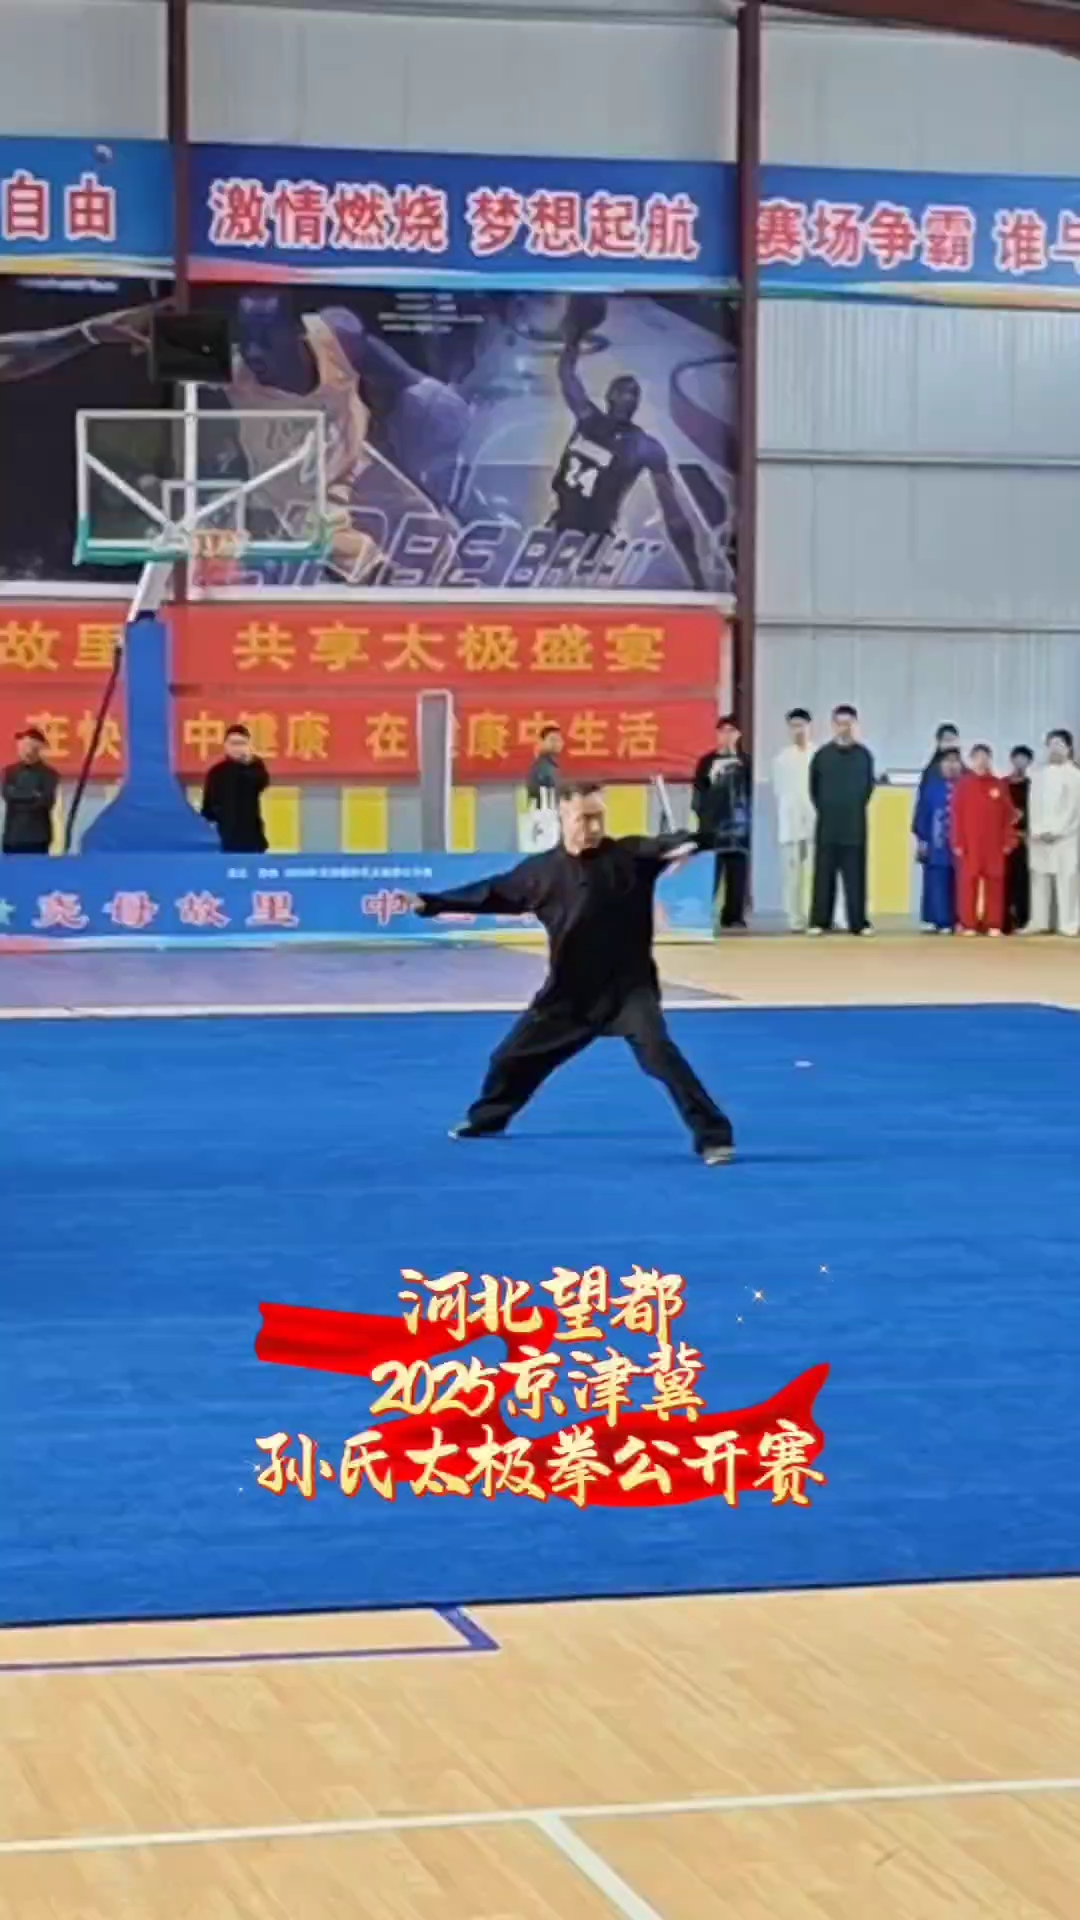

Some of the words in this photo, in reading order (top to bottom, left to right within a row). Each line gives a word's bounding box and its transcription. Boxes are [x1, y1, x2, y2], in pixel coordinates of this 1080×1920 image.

[1, 169, 116, 242] 自由
[208, 178, 448, 252] 激情燃烧
[466, 187, 698, 262] 梦想起航
[756, 197, 976, 271] 赛场争霸
[232, 620, 665, 672] 共享太极盛宴
[26, 709, 330, 761] 在快中健康
[365, 710, 660, 761] 在康中生活
